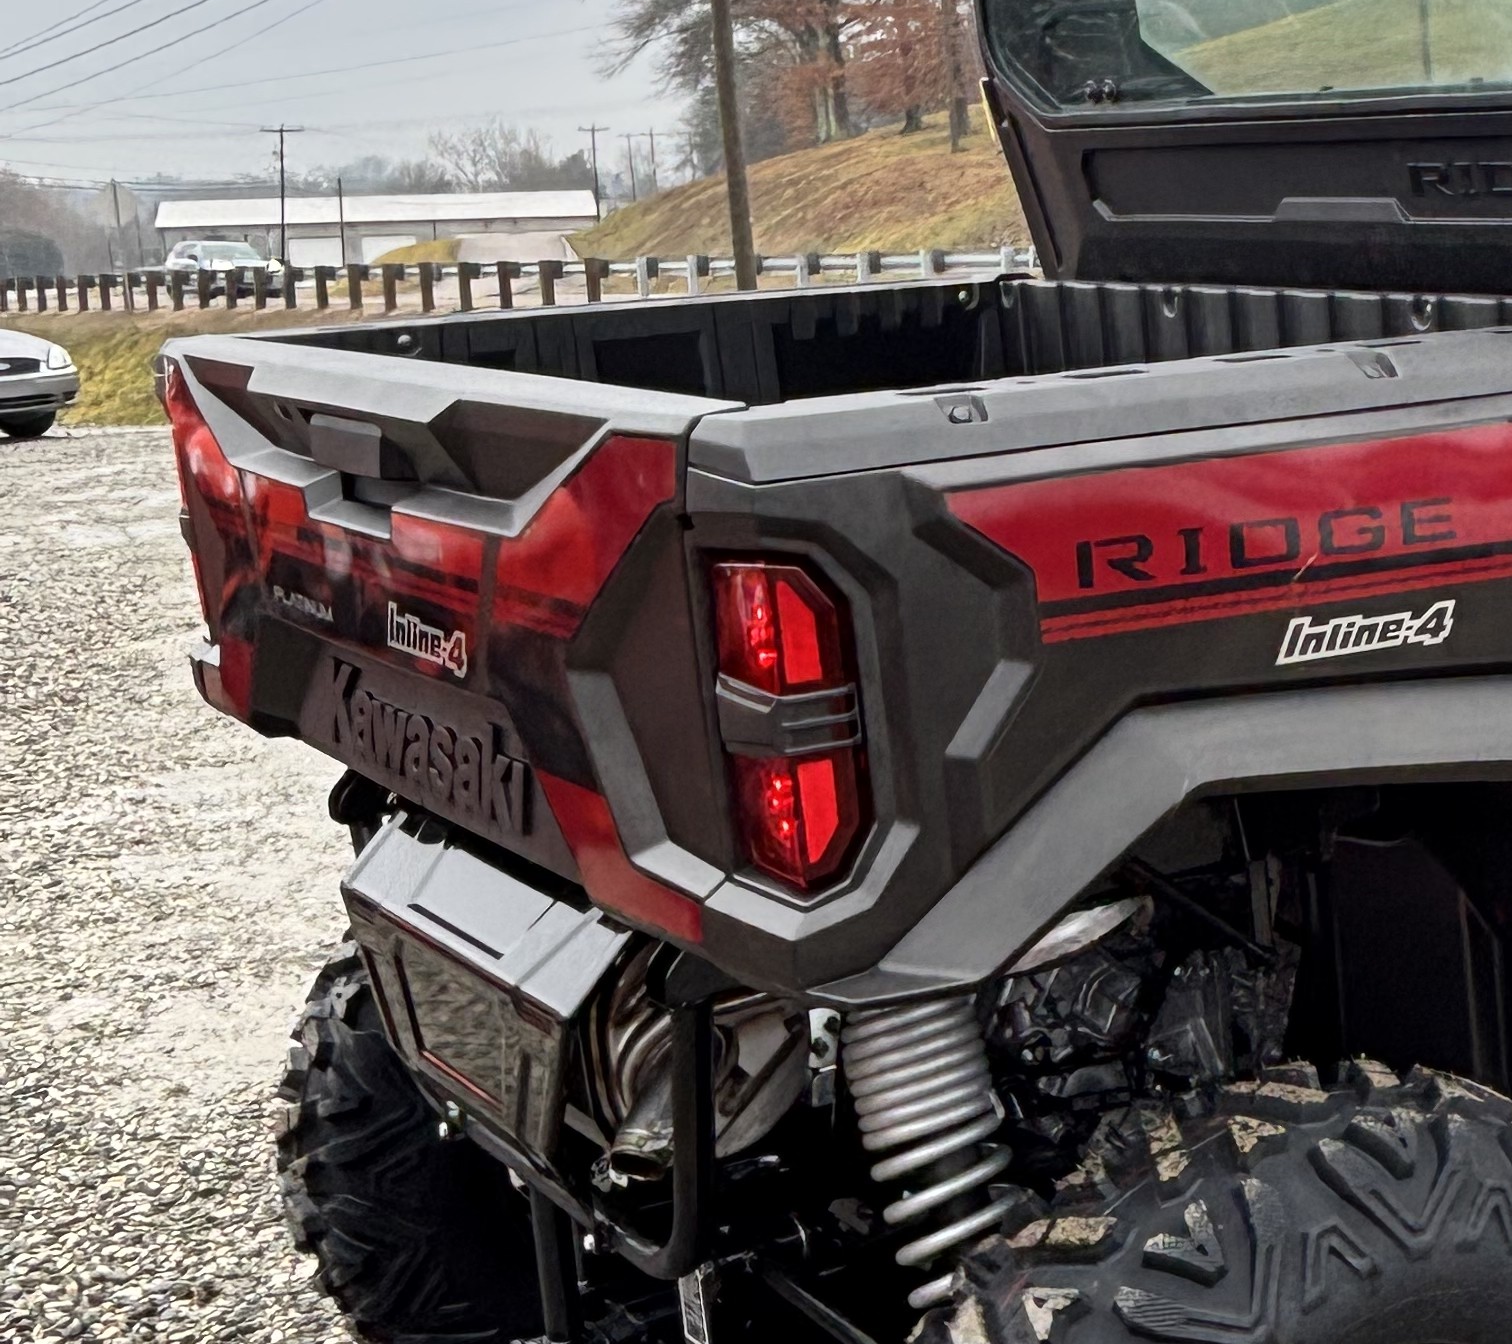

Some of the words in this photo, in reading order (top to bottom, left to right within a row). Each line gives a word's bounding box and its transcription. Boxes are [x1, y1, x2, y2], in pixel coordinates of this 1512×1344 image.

[1076, 497, 1457, 589] RIDGE
[387, 600, 468, 679] Inline-4
[1275, 599, 1456, 666] Inline-4
[329, 656, 533, 836] Kawasaki
